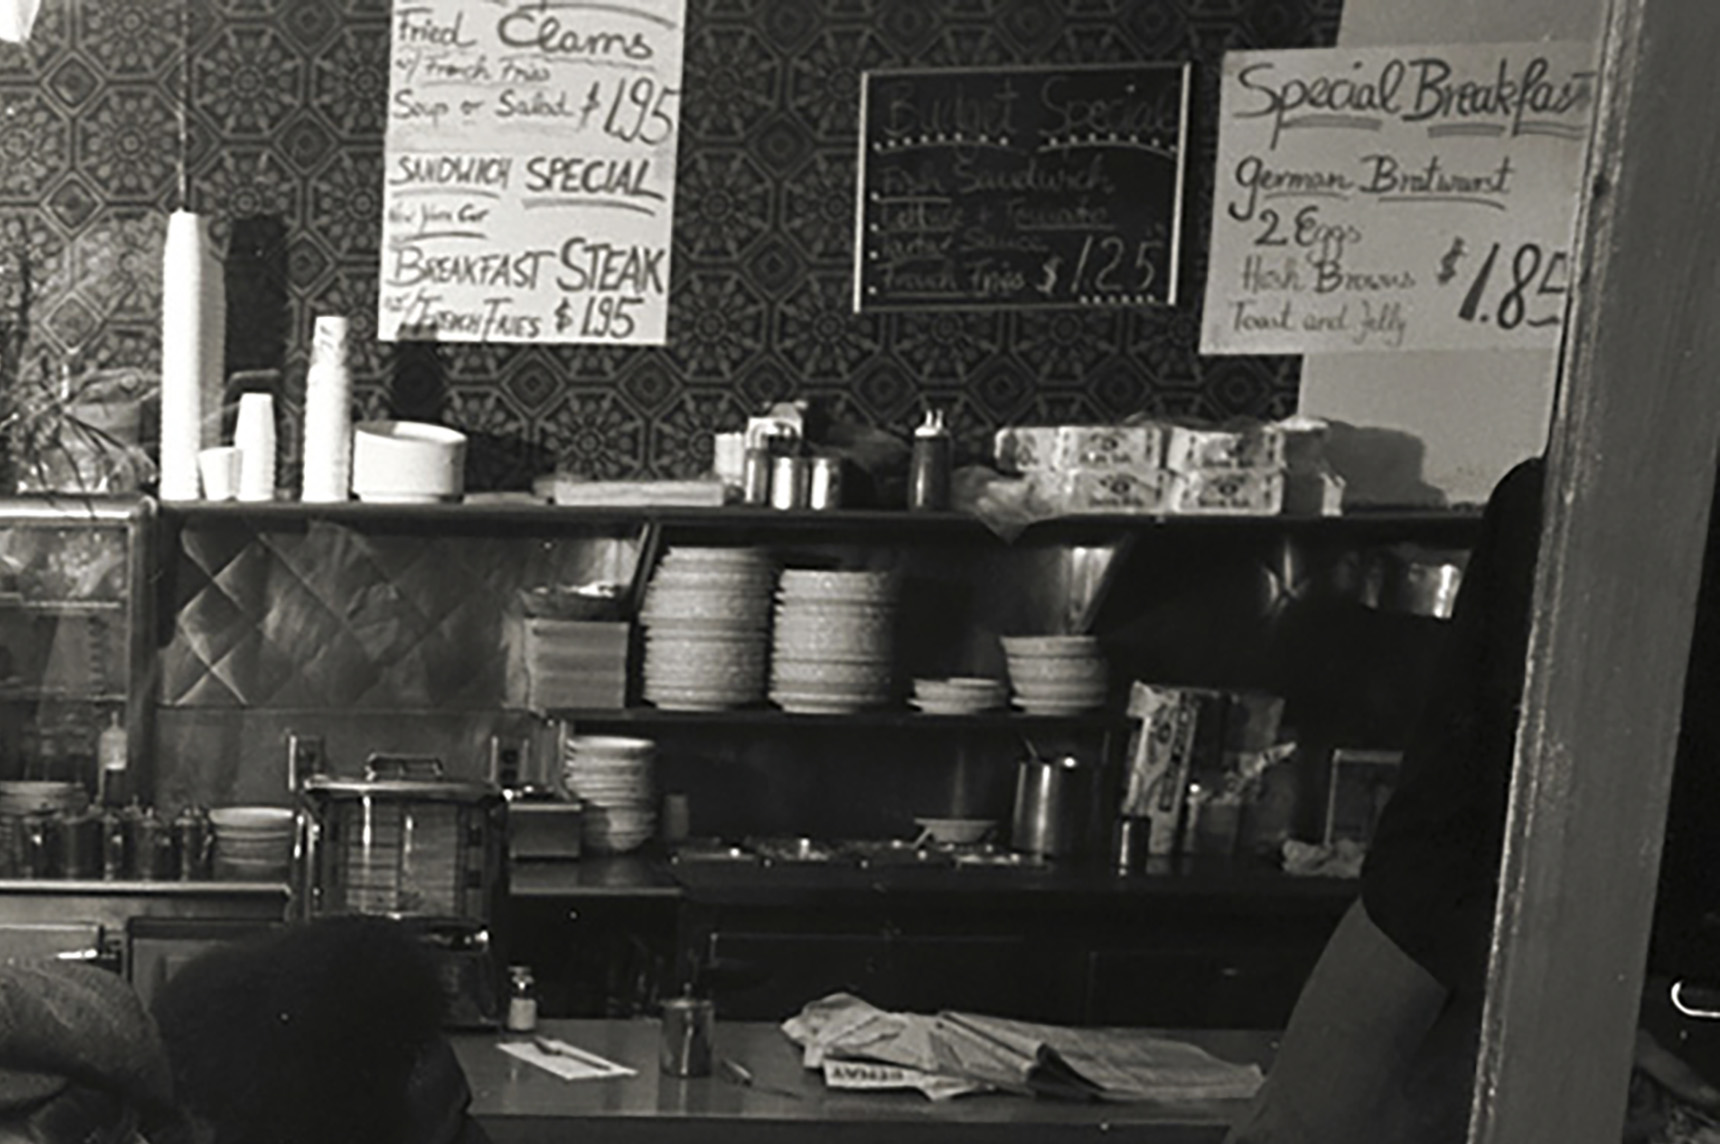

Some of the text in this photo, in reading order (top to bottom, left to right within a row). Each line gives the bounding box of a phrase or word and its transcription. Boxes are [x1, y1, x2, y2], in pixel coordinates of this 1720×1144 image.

[396, 7, 654, 60] Fried Clams
[1233, 59, 1405, 150] Special
[525, 157, 666, 201] SPECIAL
[1255, 205, 1362, 265] 2 Eggs
[385, 236, 665, 294] BREAKFAST STEAK
[1303, 304, 1346, 331] and
